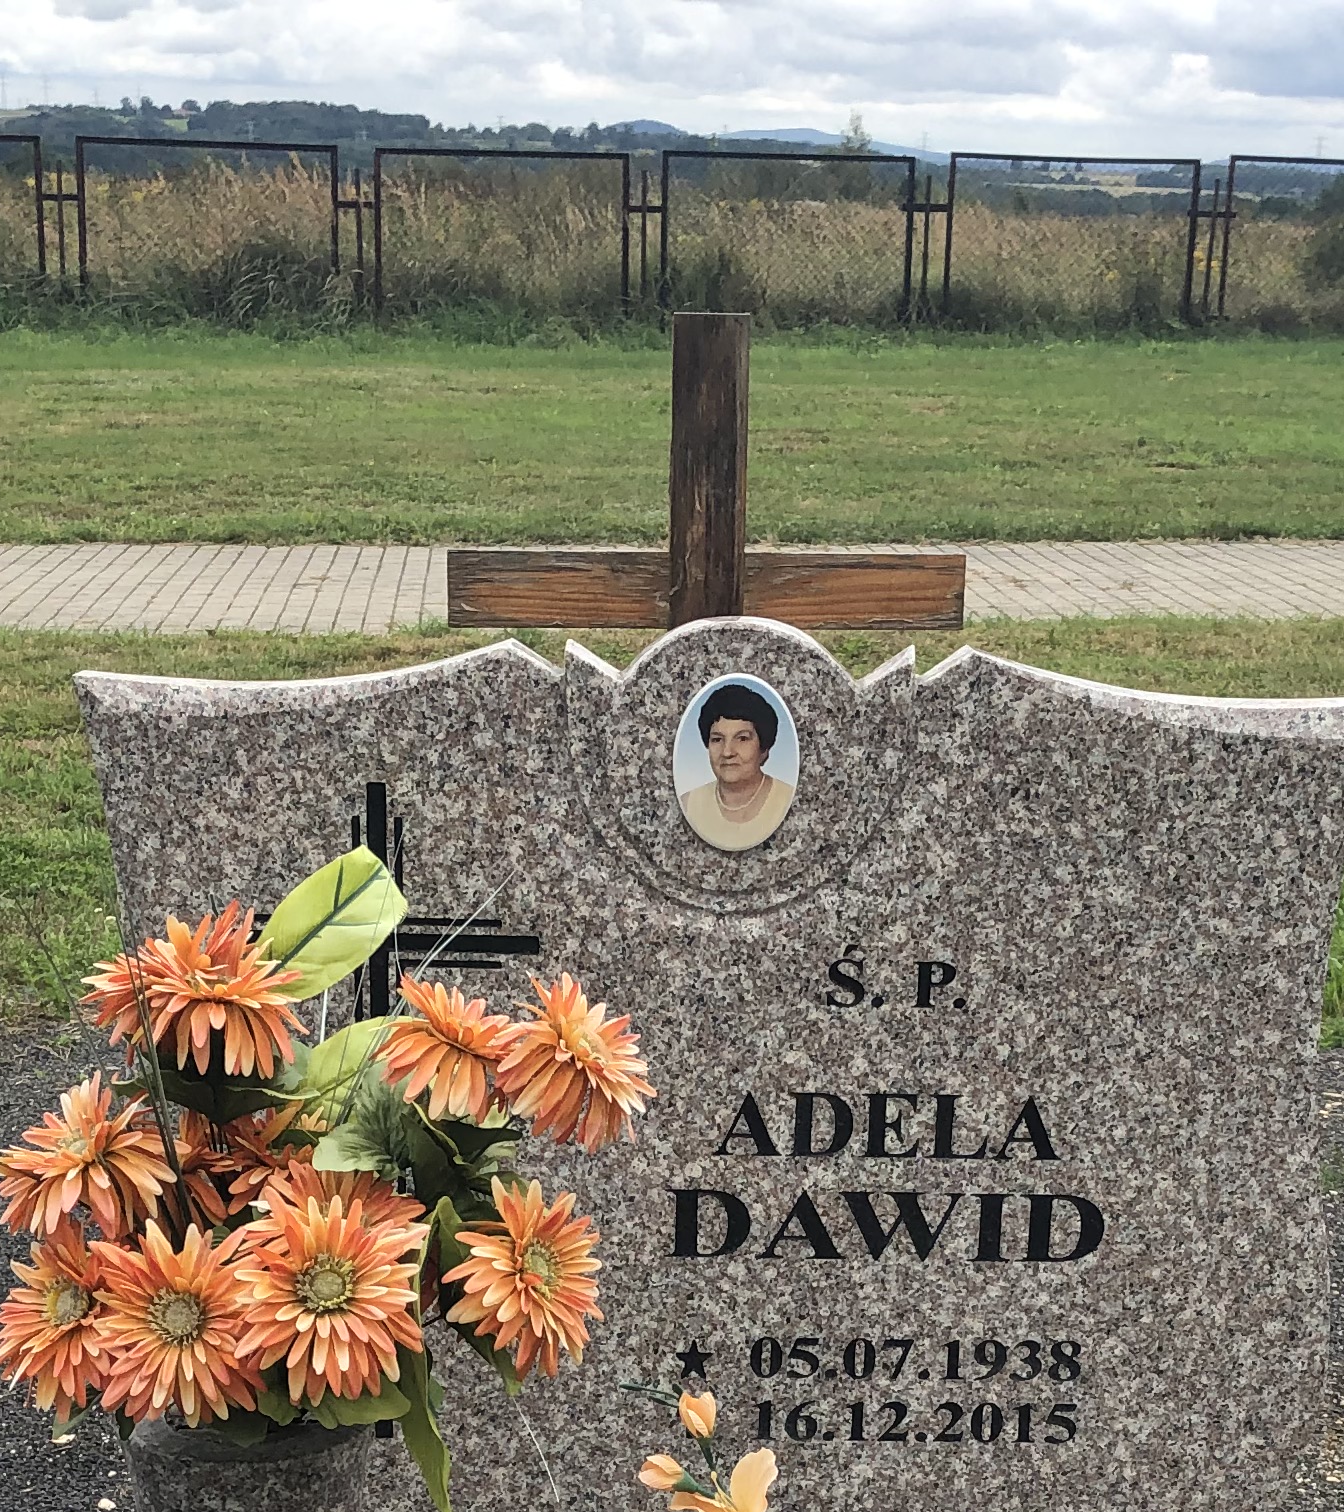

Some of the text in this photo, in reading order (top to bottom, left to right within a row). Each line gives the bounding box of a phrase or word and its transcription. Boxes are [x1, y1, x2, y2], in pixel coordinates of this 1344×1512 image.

[826, 944, 967, 1009] Ś. P.
[712, 1090, 1062, 1161] ADELA
[665, 1187, 1106, 1264] DAWID
[749, 1335, 1082, 1382] 05.07.1938
[757, 1400, 1078, 1444] 16.12.2015
